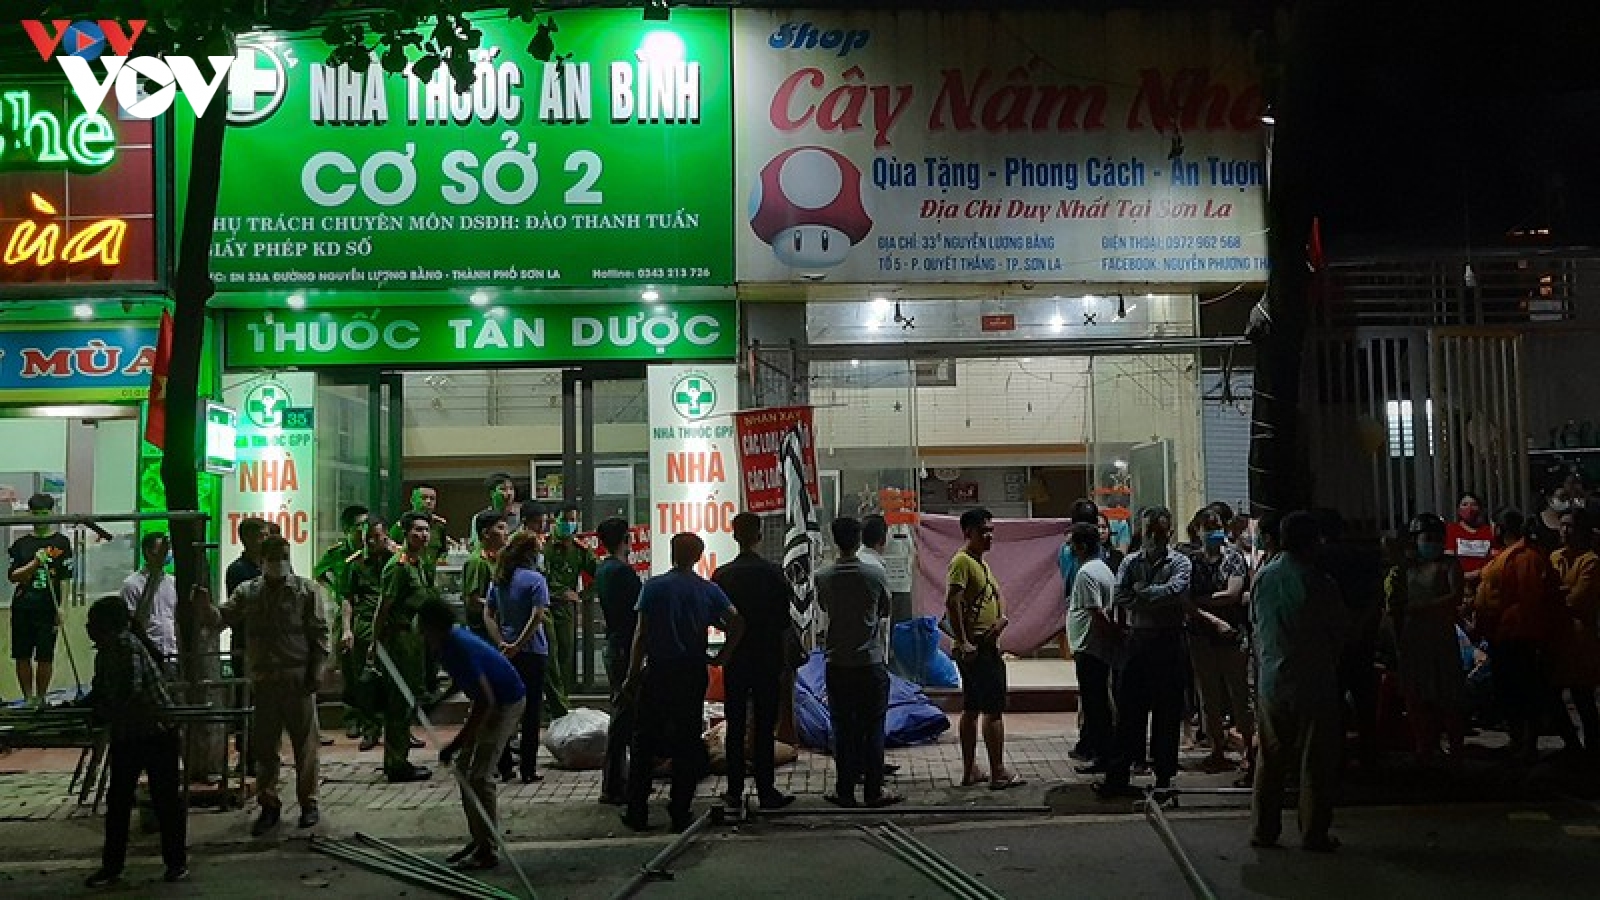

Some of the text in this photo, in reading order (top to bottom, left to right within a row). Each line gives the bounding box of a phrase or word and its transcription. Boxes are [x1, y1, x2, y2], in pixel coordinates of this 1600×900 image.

[768, 22, 870, 56] Shop
[540, 62, 592, 123] AN
[770, 65, 912, 148] Cây
[301, 130, 602, 206] CƠ SỞ 2
[924, 157, 979, 193] Tặng
[1005, 159, 1079, 191] Phong
[1087, 157, 1144, 187] Cách
[1207, 157, 1264, 192] Tượn
[213, 215, 242, 240] HỤ
[247, 212, 315, 231] TRÁCH
[321, 211, 403, 231] CHUYÊN
[410, 211, 454, 230] MÔN
[526, 209, 567, 229] ĐÀO
[572, 213, 640, 229] THANH
[646, 207, 700, 229] TUẤN
[1006, 199, 1051, 222] Duy
[1203, 199, 1233, 218] La
[253, 237, 307, 257] PHÉP
[313, 242, 341, 257] KD
[346, 235, 372, 256] SỐ
[1050, 258, 1062, 271] LA
[548, 269, 561, 279] LA
[592, 269, 634, 280] Hotline:
[248, 306, 720, 354] THUỐC TÂN DƯỢC
[239, 451, 298, 492] NHÀ
[666, 443, 725, 484] NHÀ
[228, 499, 310, 544] TỐC
[656, 489, 735, 534] THUỐC
